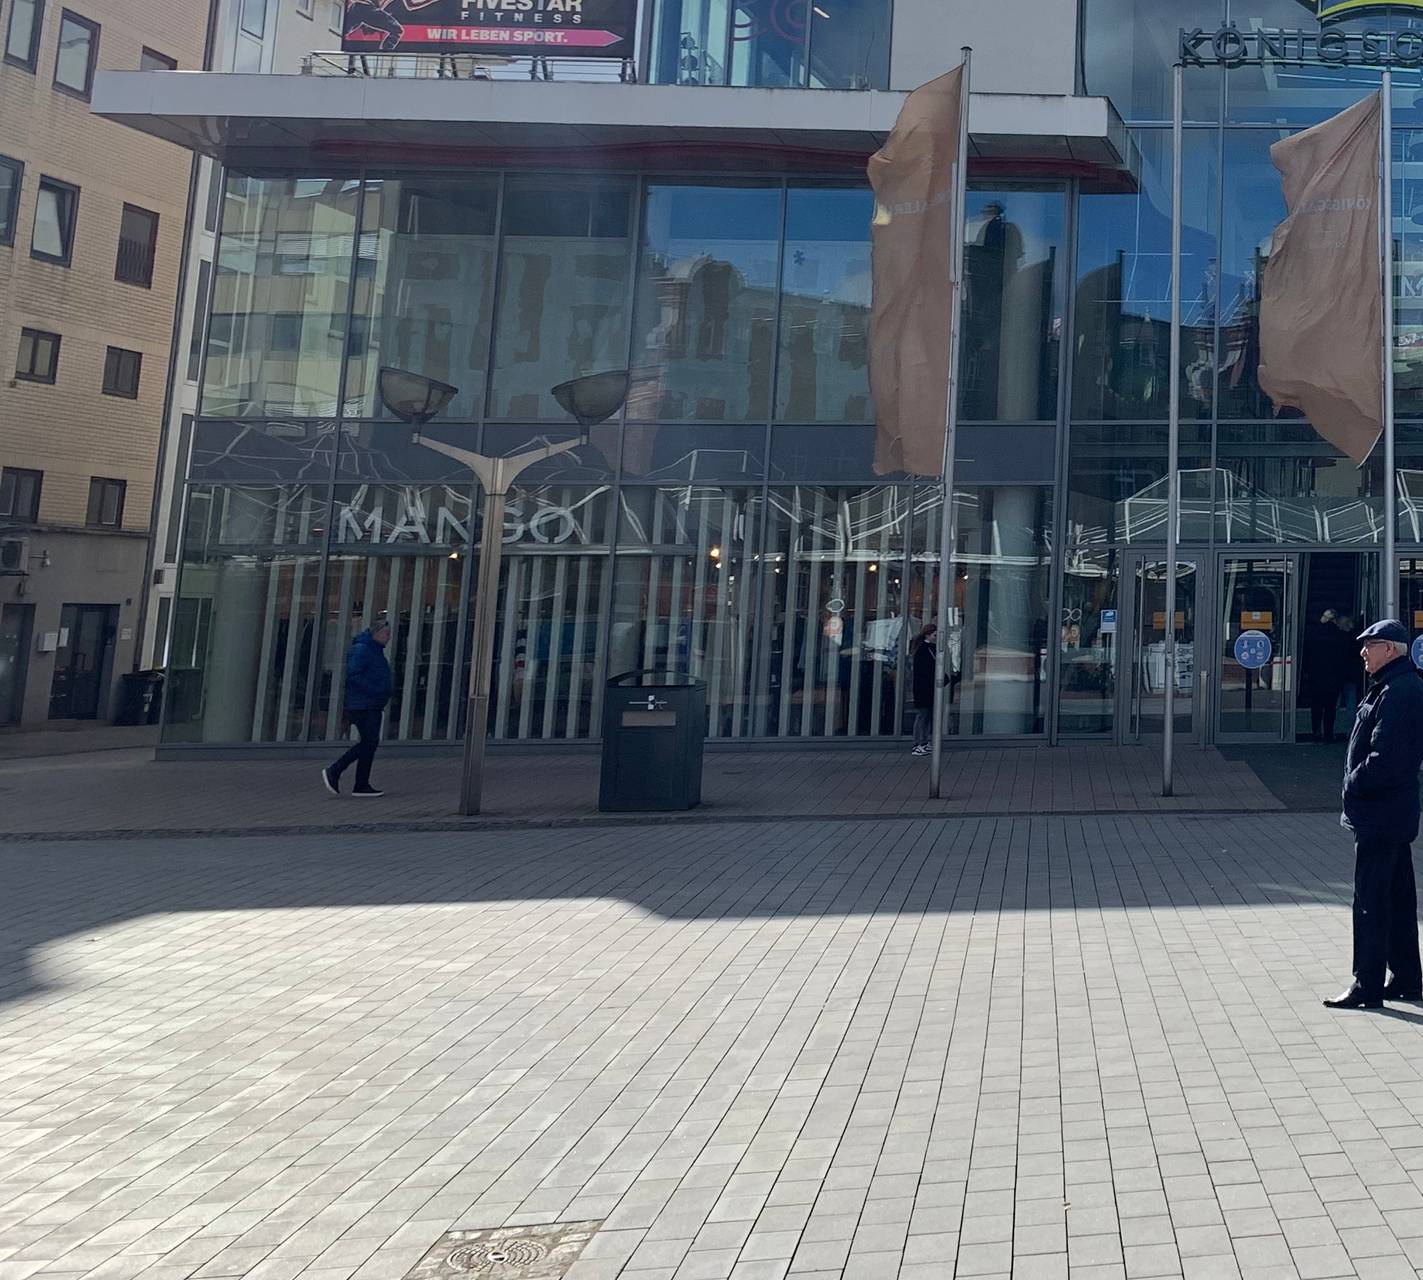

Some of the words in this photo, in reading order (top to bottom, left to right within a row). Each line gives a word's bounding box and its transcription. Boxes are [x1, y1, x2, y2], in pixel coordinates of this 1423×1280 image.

[461, 0, 582, 11] FIVESTAR
[461, 11, 582, 24] FITNESS
[427, 28, 458, 40] WIR
[461, 29, 510, 41] LEBEN
[513, 30, 569, 43] SPORT.
